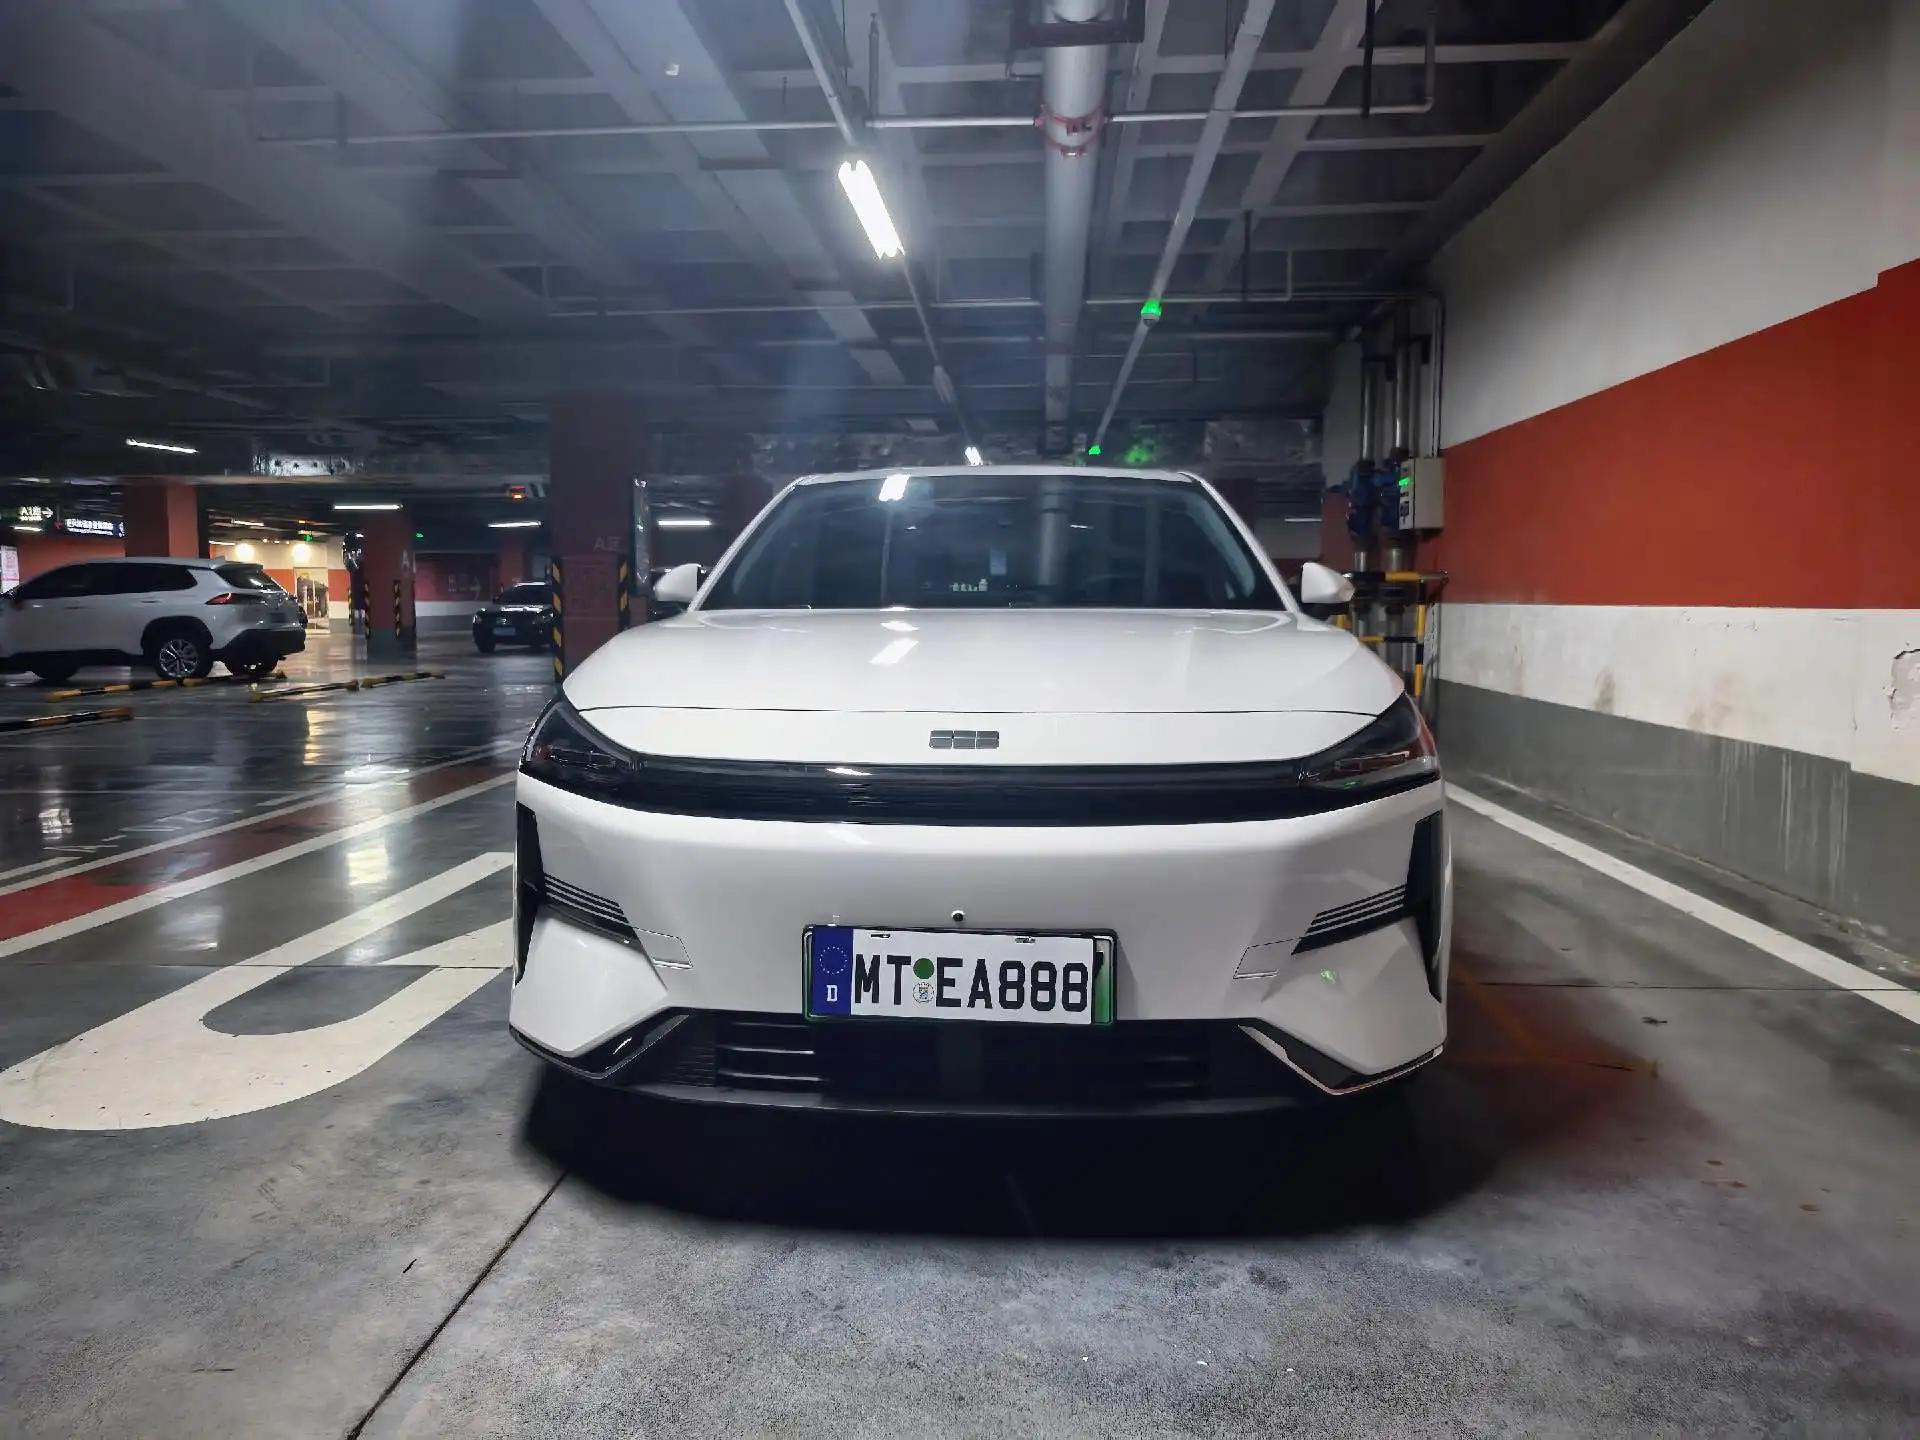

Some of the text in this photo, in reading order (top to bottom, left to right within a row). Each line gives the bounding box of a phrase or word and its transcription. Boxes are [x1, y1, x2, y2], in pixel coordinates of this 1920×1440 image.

[826, 984, 838, 1002] D
[854, 953, 1089, 1012] MT EA888
